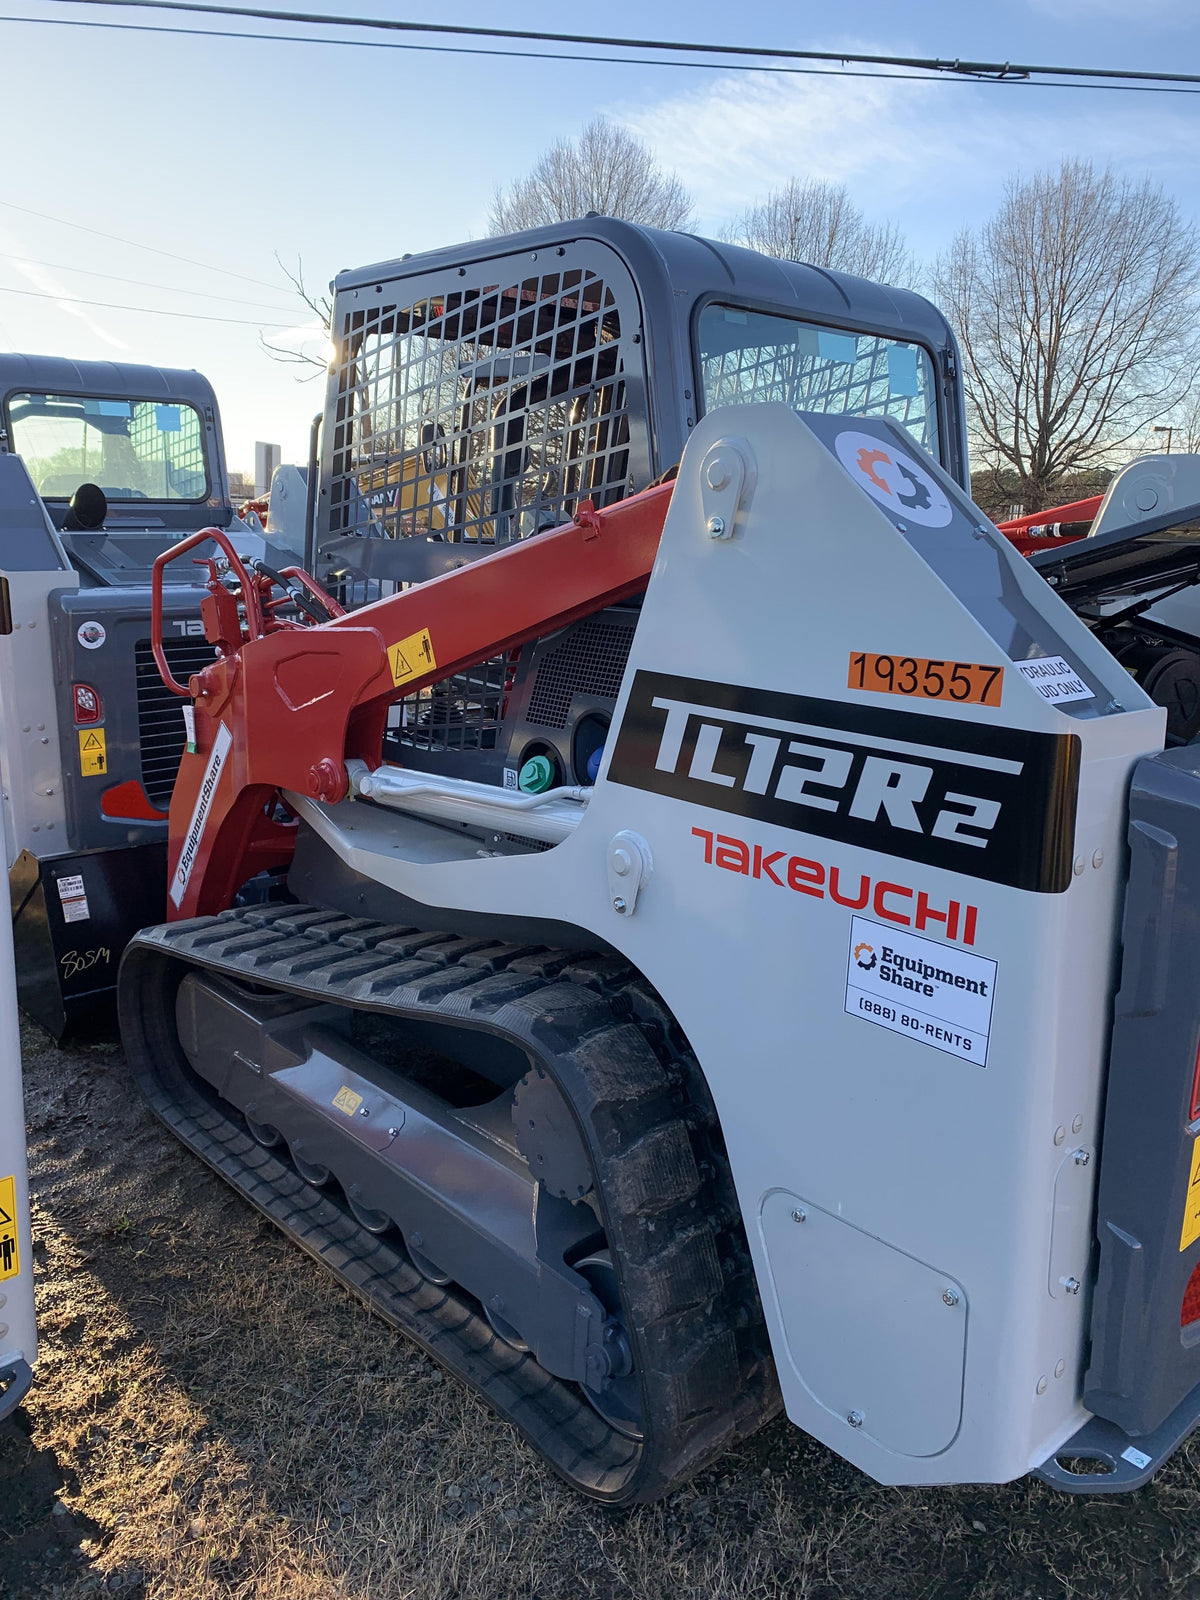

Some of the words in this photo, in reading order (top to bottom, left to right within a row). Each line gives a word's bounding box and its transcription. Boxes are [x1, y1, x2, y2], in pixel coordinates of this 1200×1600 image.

[853, 654, 1002, 703] 193557
[1020, 662, 1071, 680] DRAULIC
[1036, 684, 1060, 698] UID
[1057, 680, 1087, 695] ONLY
[181, 754, 222, 869] EquipmentShare
[879, 964, 934, 997] Share
[881, 946, 988, 997] Equipment
[859, 997, 896, 1022] (888)
[901, 1015, 972, 1051] 80-RENTS
